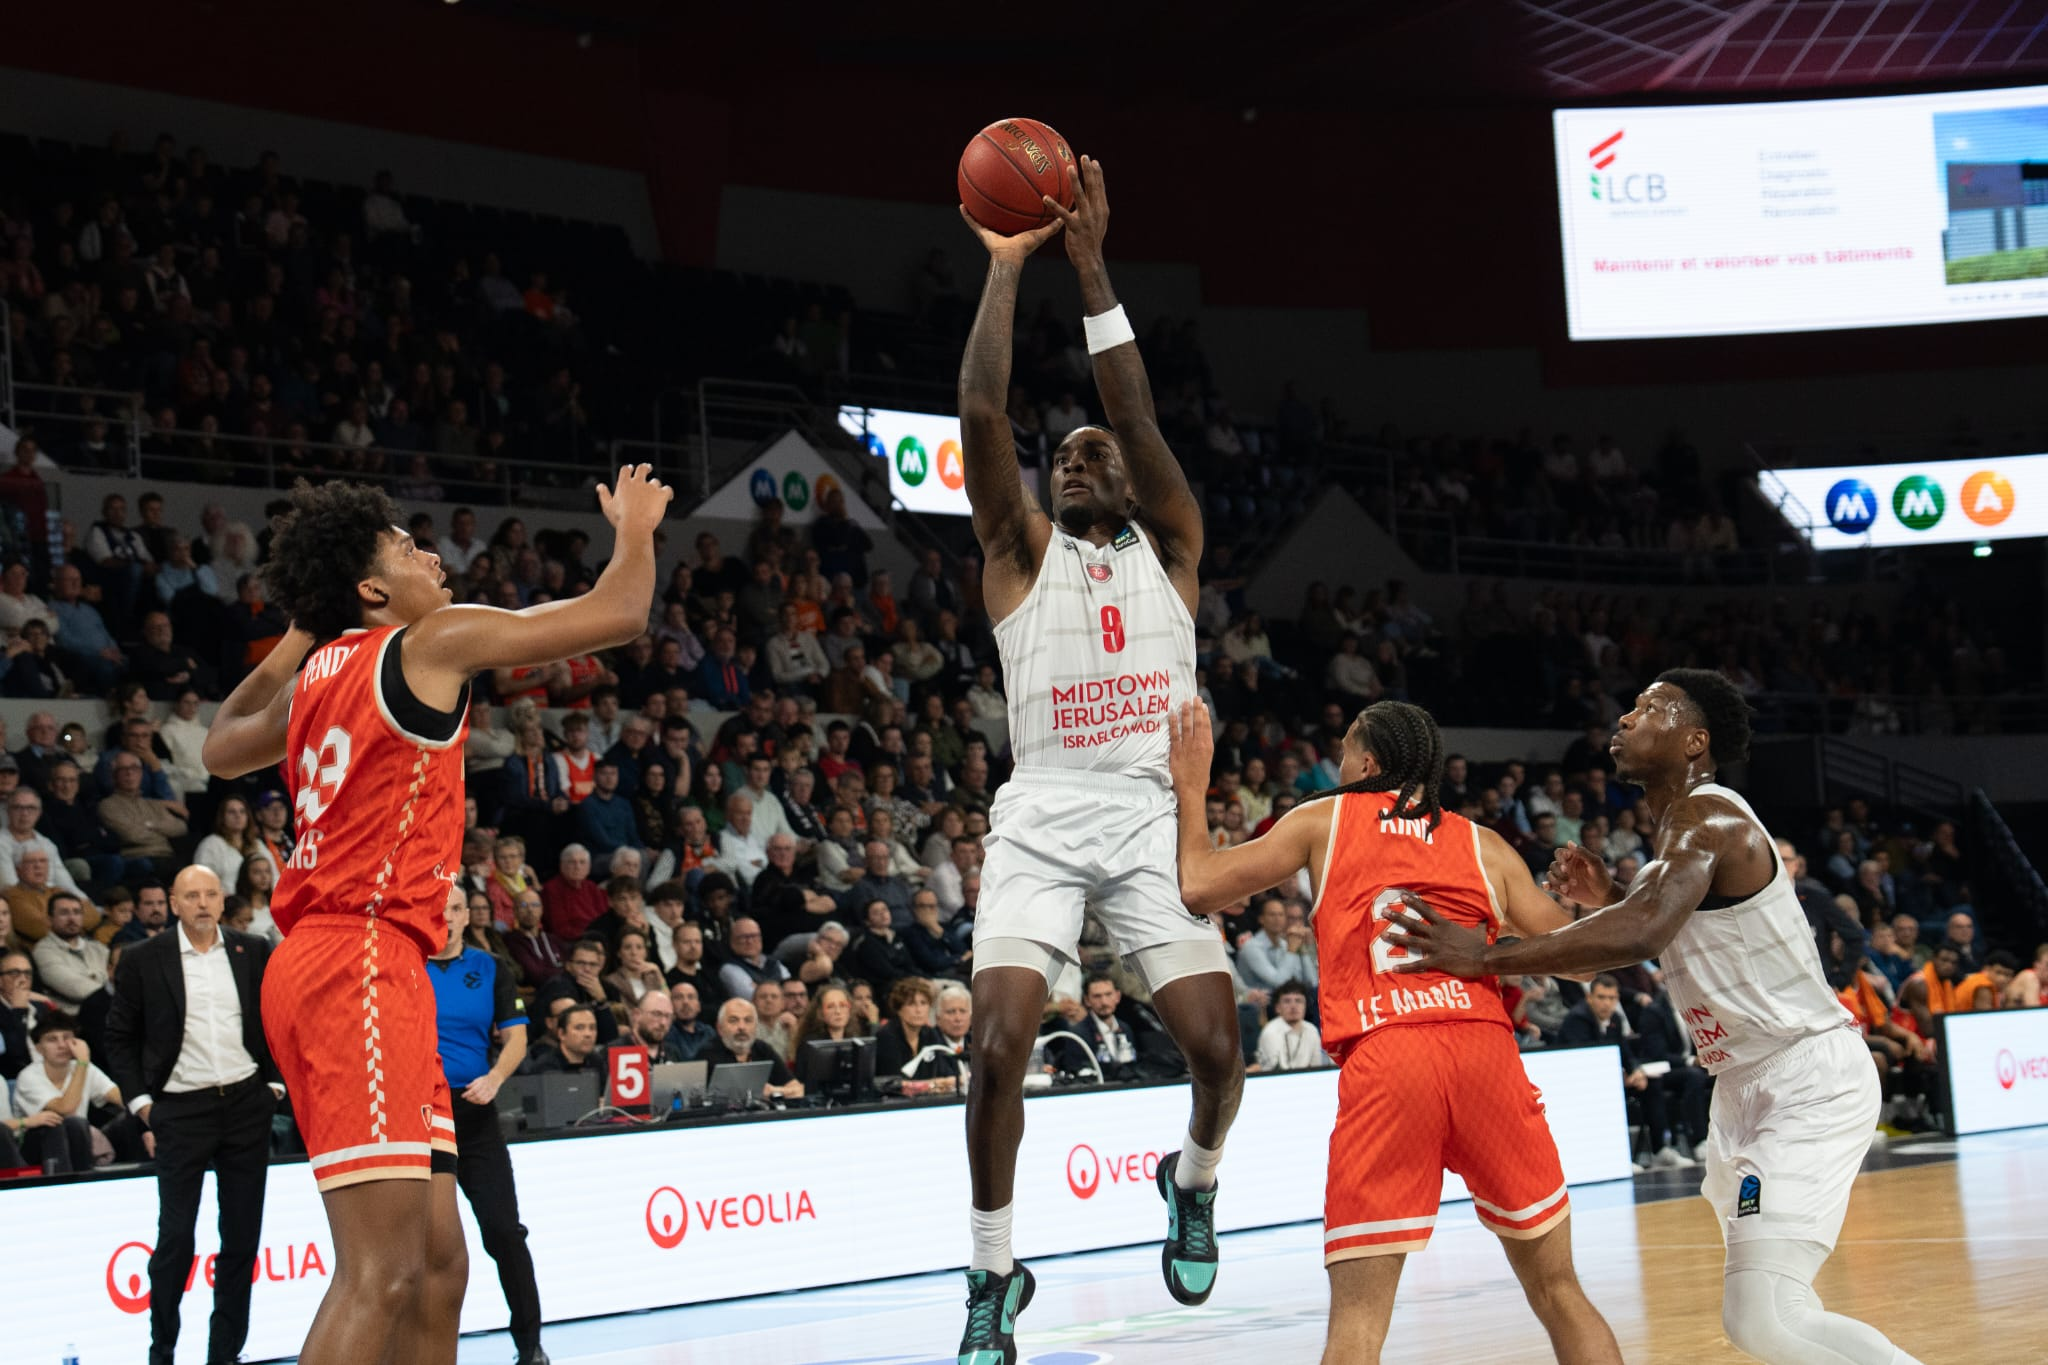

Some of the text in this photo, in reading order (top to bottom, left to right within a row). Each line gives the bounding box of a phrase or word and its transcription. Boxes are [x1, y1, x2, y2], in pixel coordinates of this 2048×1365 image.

[1000, 121, 1053, 175] SPALDIN
[1607, 173, 1667, 203] LCB
[1594, 258, 1673, 272] Maintenir
[1681, 257, 1696, 270] et
[1704, 253, 1779, 270] valoriser
[1788, 252, 1817, 265] vos
[1100, 605, 1125, 654] 9
[1052, 669, 1170, 705] MIDTOWN
[1052, 693, 1170, 731] JERUSALEM
[1370, 887, 1426, 975] 2
[1357, 979, 1473, 1032] LE MANS
[616, 1053, 644, 1099] 5
[1106, 1151, 1166, 1184] VEO
[696, 1190, 816, 1231] VEOLIA
